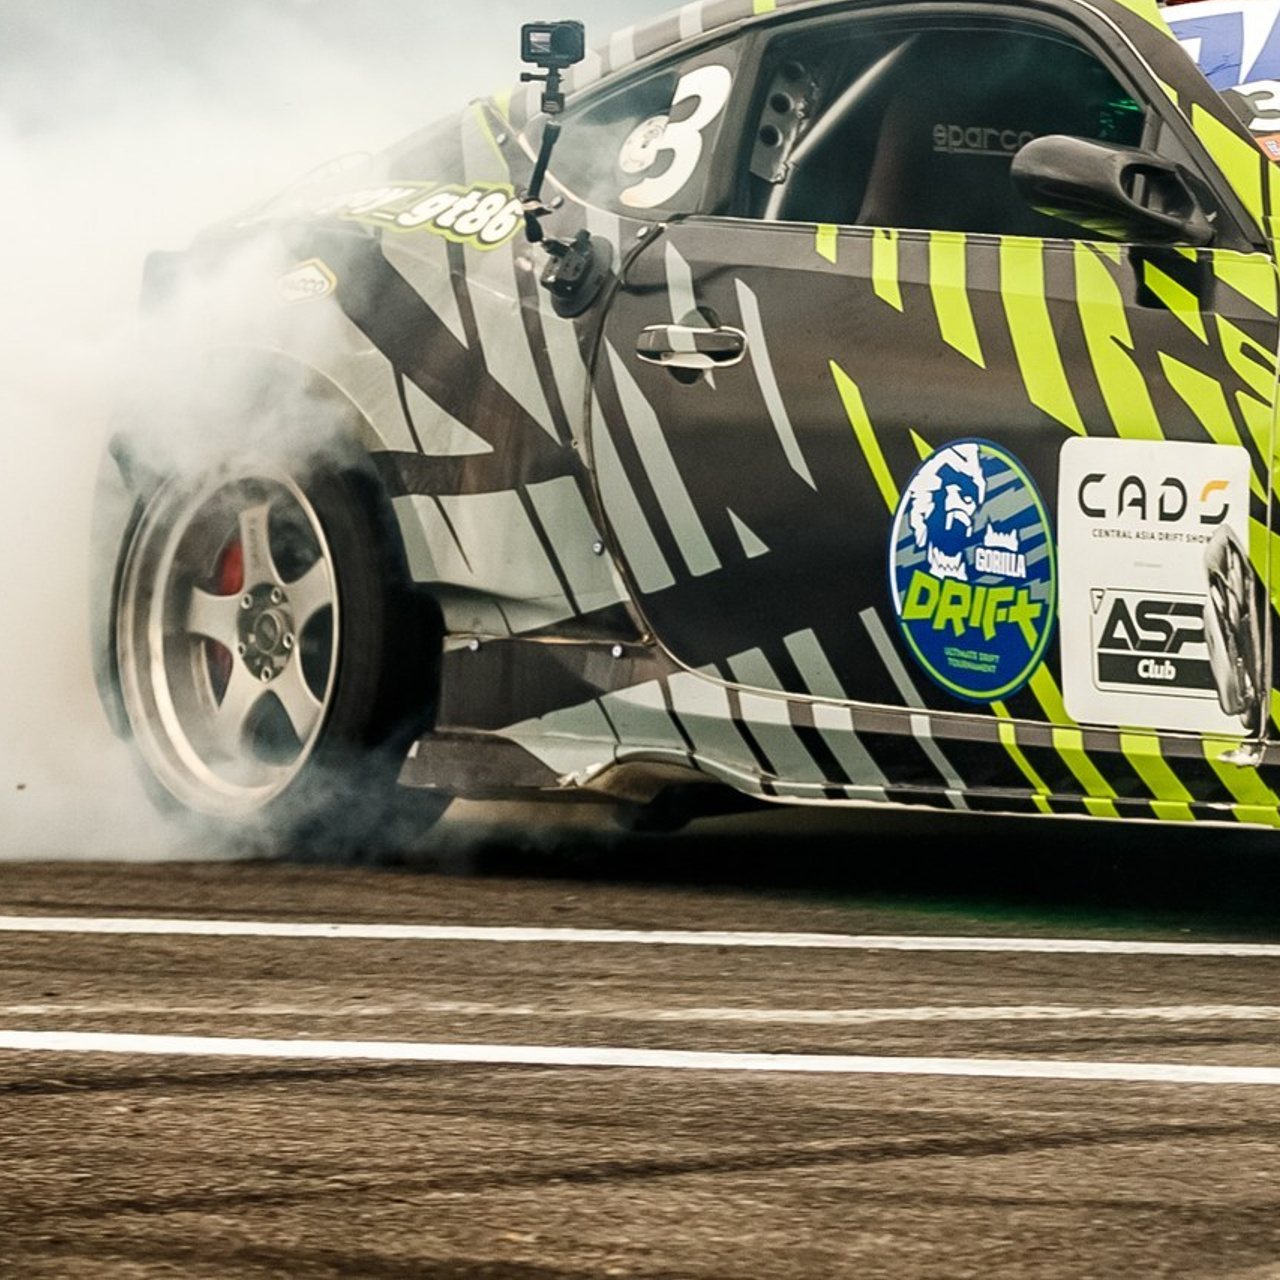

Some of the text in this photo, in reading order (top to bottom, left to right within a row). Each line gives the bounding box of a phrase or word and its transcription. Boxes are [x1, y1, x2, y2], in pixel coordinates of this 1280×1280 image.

[619, 65, 732, 208] 3
[1078, 473, 1229, 525] CADS
[1092, 528, 1132, 539] CENTRAL
[1135, 530, 1155, 541] ASIA
[1158, 531, 1183, 542] DRIFT
[975, 547, 1027, 579] GORILLA
[902, 570, 1042, 651] DRIFT
[1137, 658, 1176, 680] Club
